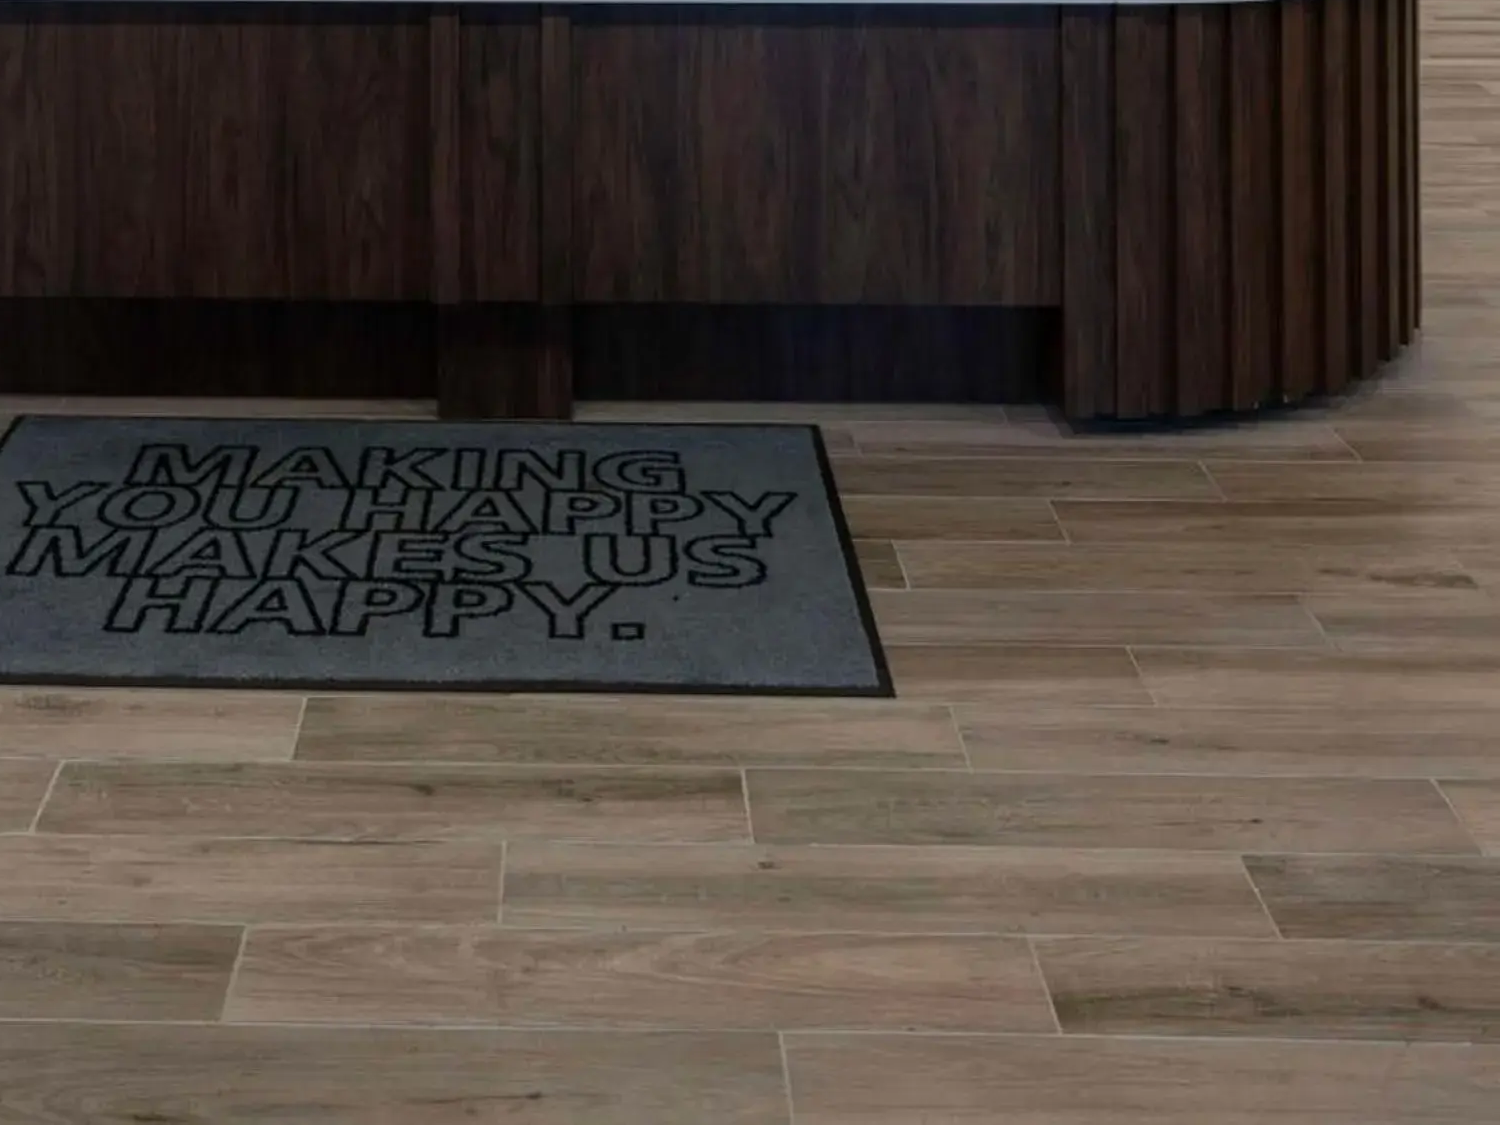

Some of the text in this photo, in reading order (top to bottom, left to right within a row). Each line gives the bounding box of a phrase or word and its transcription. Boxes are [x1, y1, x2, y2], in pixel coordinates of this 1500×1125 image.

[123, 444, 686, 494] MAKING
[16, 481, 798, 538] YOU HAPPY
[6, 526, 768, 588] MAKES US
[103, 574, 646, 641] HAPPY.
